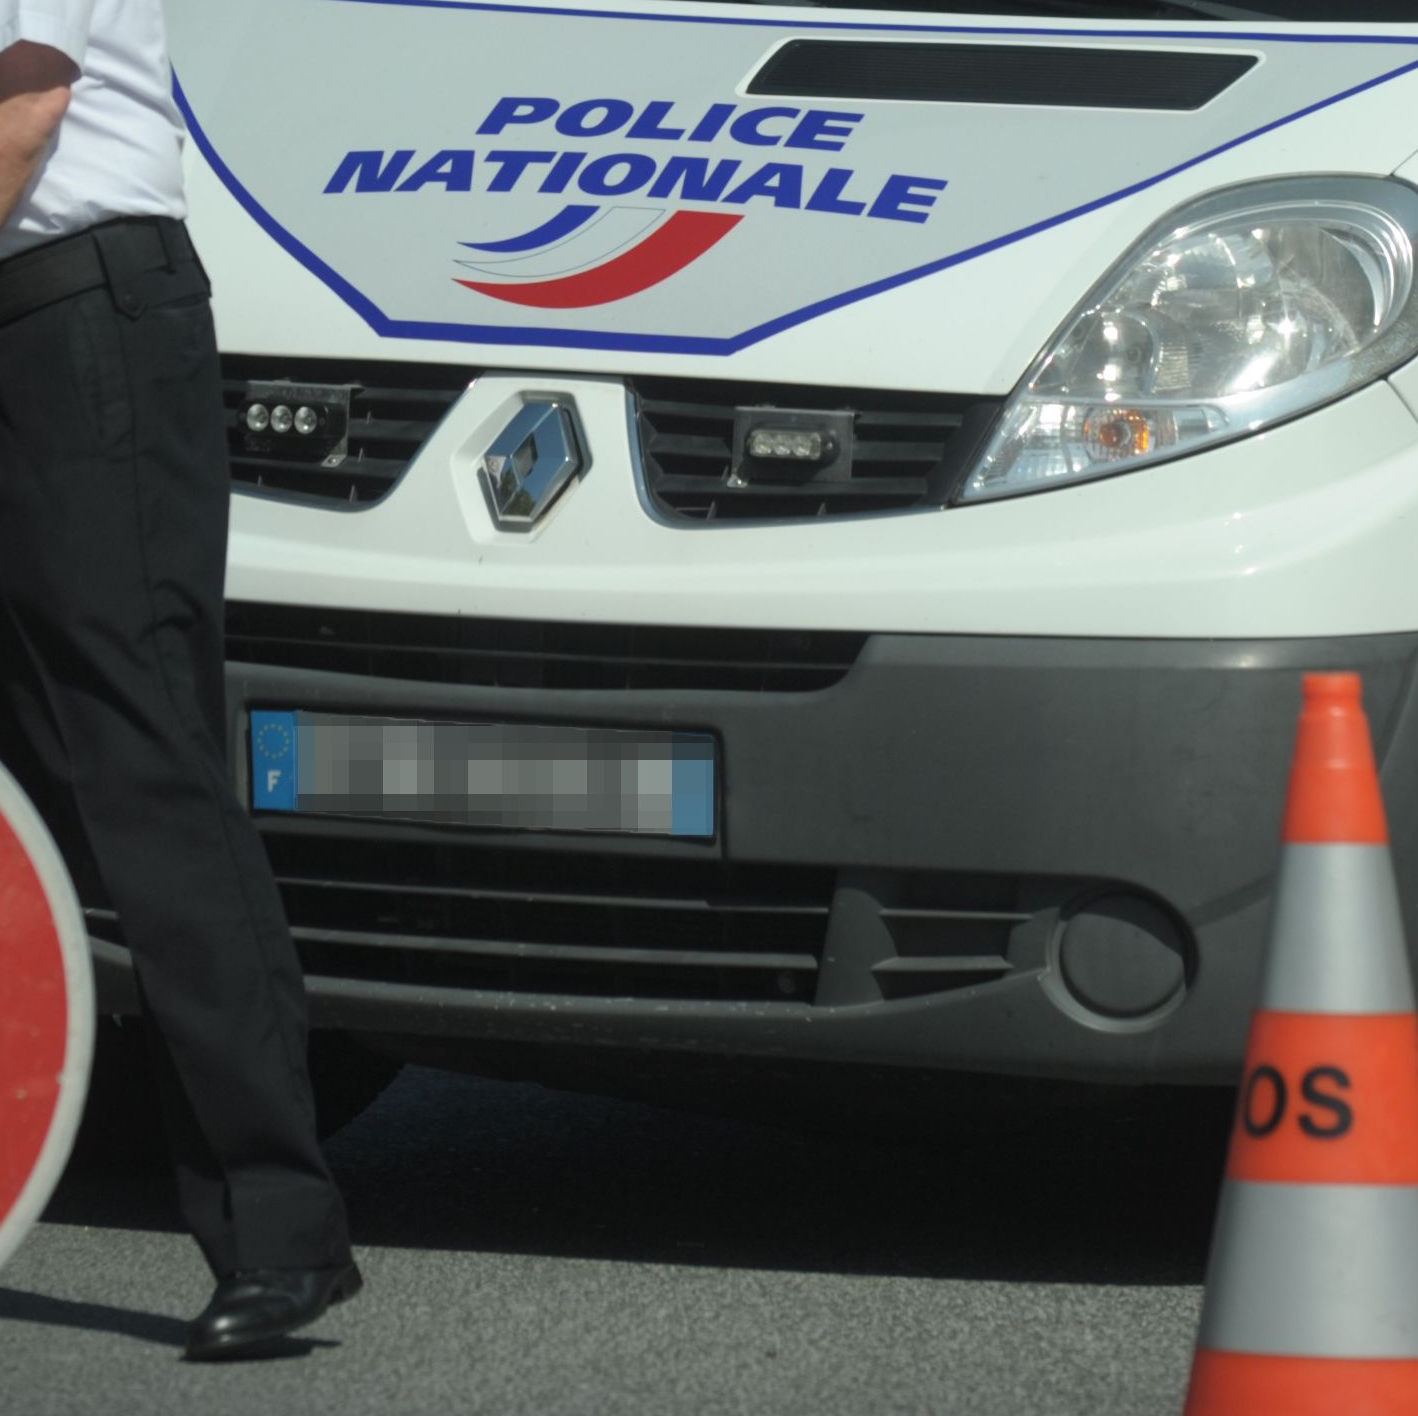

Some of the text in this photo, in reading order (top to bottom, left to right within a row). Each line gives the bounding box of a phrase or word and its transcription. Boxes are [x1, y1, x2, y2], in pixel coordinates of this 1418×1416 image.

[476, 95, 866, 152] POLICE
[322, 148, 948, 225] NATIONALE
[267, 769, 282, 793] F
